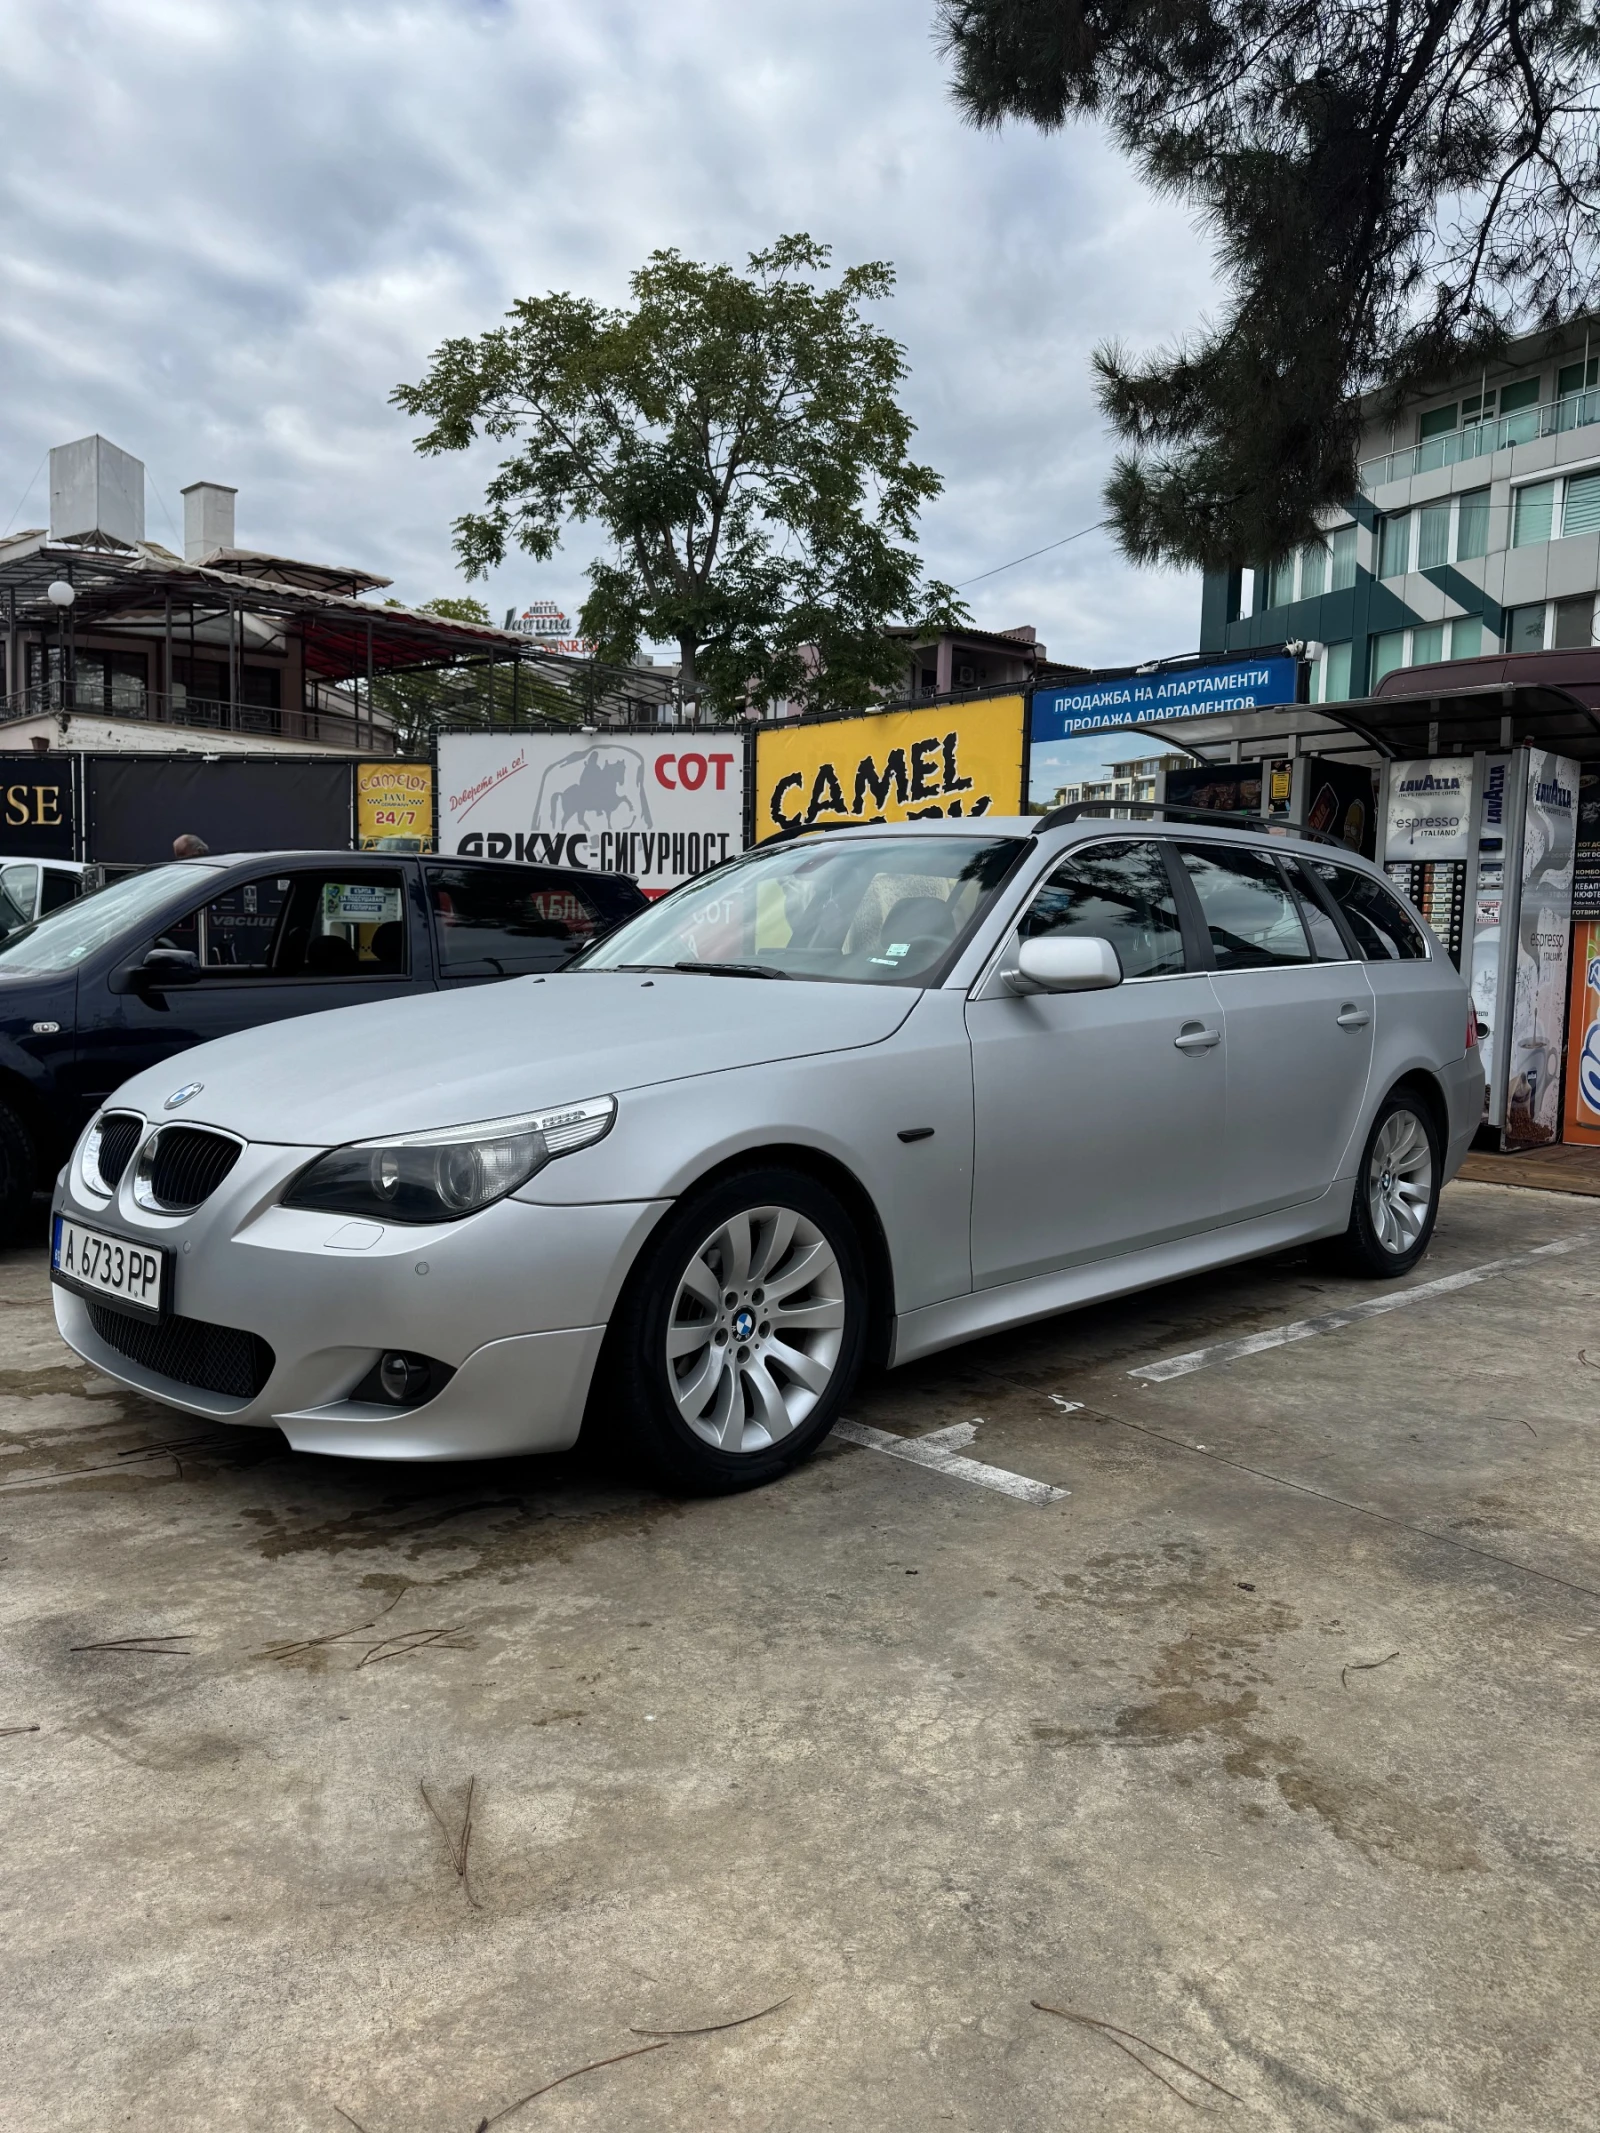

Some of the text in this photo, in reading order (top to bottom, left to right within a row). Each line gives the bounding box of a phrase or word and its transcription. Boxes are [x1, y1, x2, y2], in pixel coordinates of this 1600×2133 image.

[530, 606, 557, 614] HOTEL
[1054, 670, 1270, 714] ПРОДАЖБА НА АПАРТАМЕНТИ
[1064, 696, 1256, 733] ПРОДАЖА АПАРТАМЕНТОВ
[450, 748, 526, 813] Доверете ни се!
[654, 753, 734, 791] СОТ
[770, 731, 974, 831] CAMEL
[1399, 775, 1460, 792] LAVAZZA
[0, 785, 63, 825] SE
[384, 793, 406, 801] TAXI
[1483, 765, 1505, 824] LAVAZZA
[375, 811, 416, 826] 24/7
[1396, 816, 1460, 836] espresso
[1421, 829, 1457, 837] ITALIANO
[1574, 882, 1600, 890] КЕБАП
[1530, 932, 1565, 949] espresso
[65, 1229, 157, 1298] A 6733 PP
